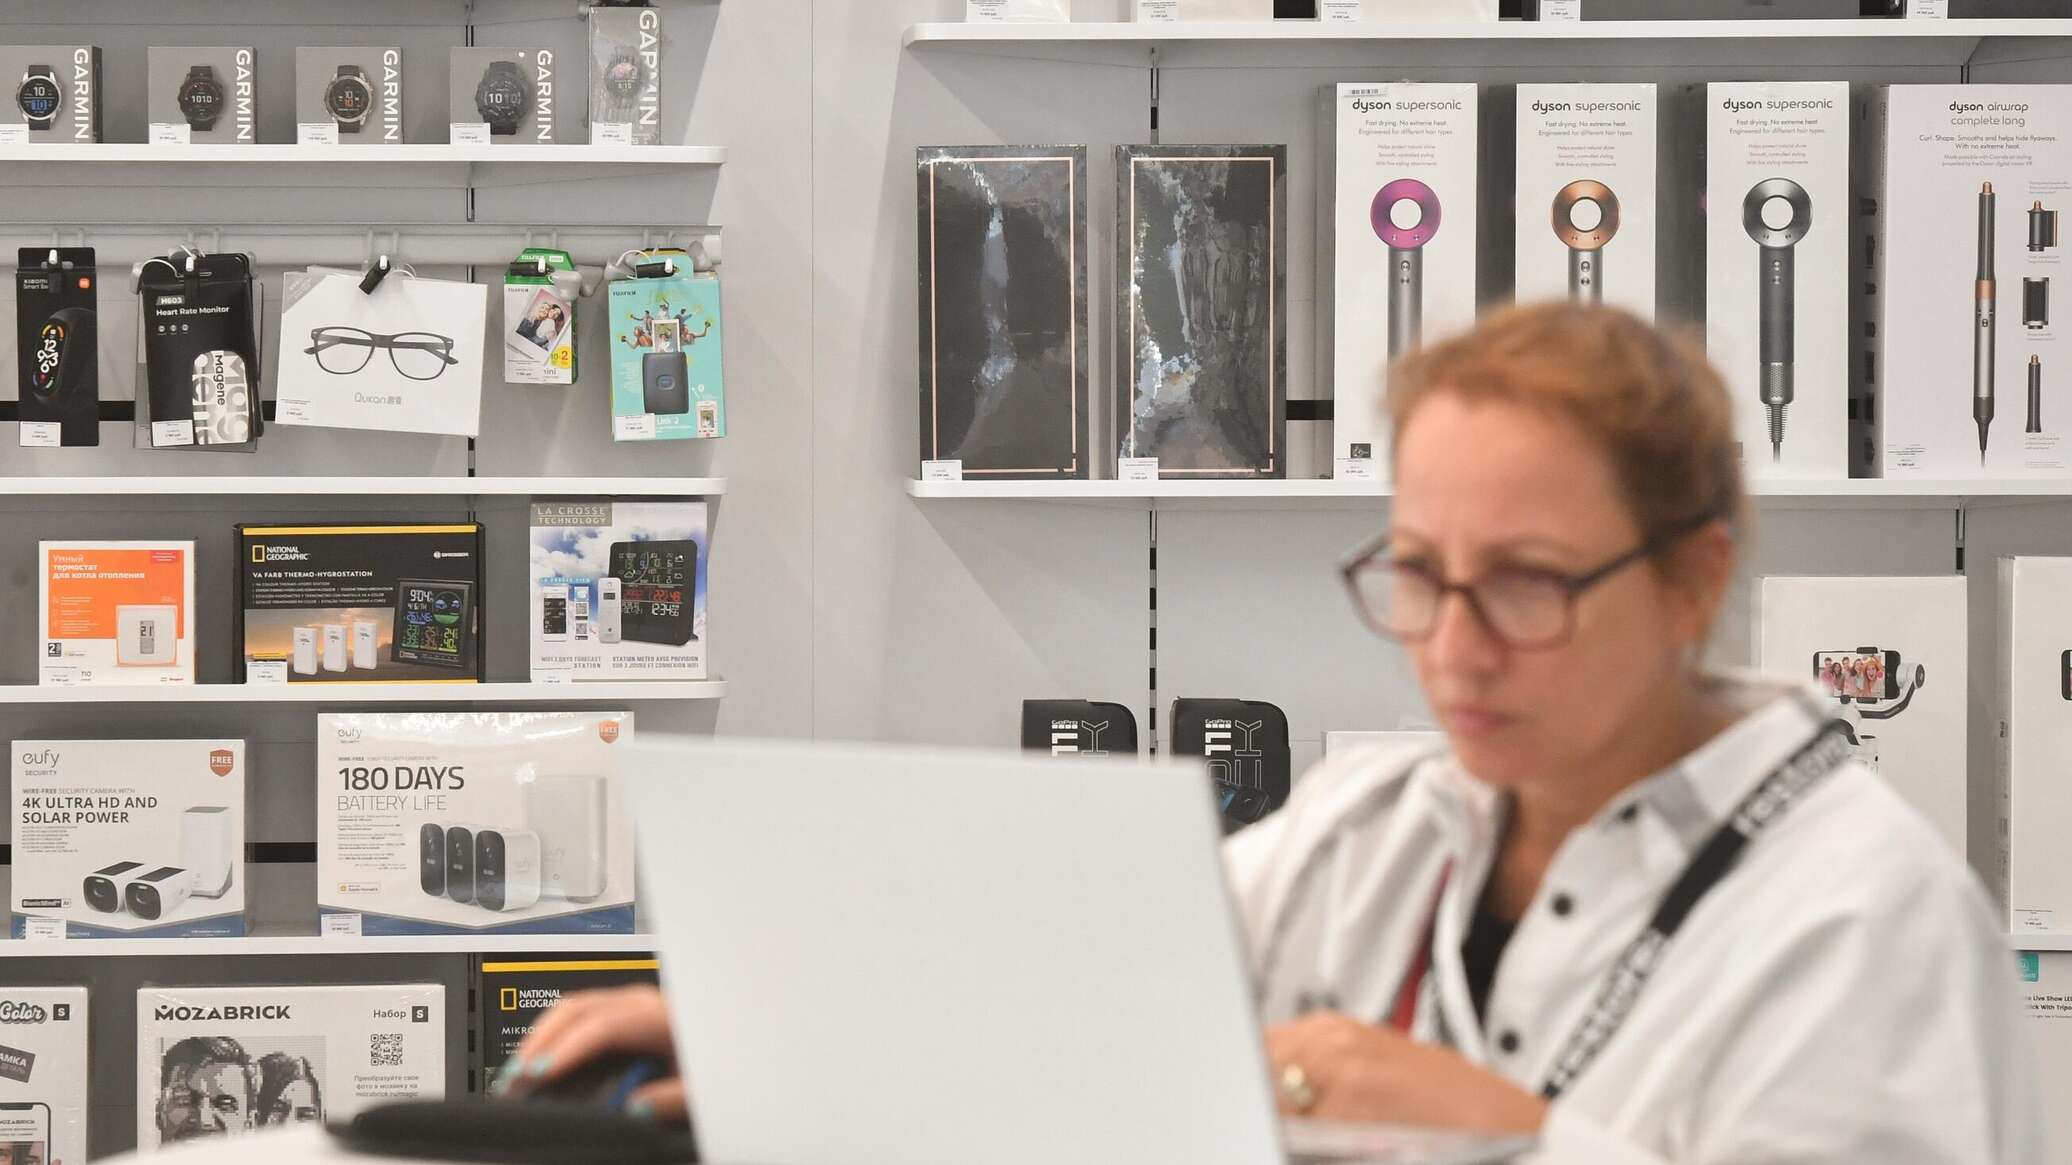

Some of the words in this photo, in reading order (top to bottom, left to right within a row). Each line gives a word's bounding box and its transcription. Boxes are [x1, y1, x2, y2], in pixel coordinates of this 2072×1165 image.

[639, 10, 657, 125] GARMIN
[33, 87, 45, 96] 10
[74, 48, 89, 139] GARMIN
[236, 49, 250, 140] GARMIN
[383, 50, 398, 140] GARMIN
[537, 50, 551, 140] GARMIN
[1352, 98, 1391, 113] dyson
[1395, 99, 1462, 112] supersonic
[1532, 100, 1571, 114] dyson
[1575, 100, 1641, 113] supersonic
[1723, 98, 1762, 113] dyson
[1766, 98, 1833, 111] supersonic
[1949, 101, 1983, 113] dyson
[1987, 101, 2029, 113] airwrap
[1950, 115, 2000, 127] complete
[2001, 115, 2025, 127] long
[1958, 134, 1984, 142] Smooths
[1985, 134, 1996, 142] and
[1998, 134, 2014, 142] helps
[2016, 134, 2028, 142] hide
[179, 307, 197, 315] Rate
[199, 305, 230, 314] Monitor
[213, 354, 226, 405] Magene
[537, 506, 552, 515] LA
[558, 506, 605, 515] CROSSE
[53, 554, 84, 563] Умный
[266, 553, 309, 561] GEOGRAPHIC
[284, 570, 373, 578] THERMO-HYGROSTATION
[49, 644, 56, 654] 2
[338, 727, 361, 740] eufy
[22, 749, 60, 767] eufy
[211, 756, 233, 764] FREE
[24, 769, 57, 777] SECURITY
[338, 766, 388, 790] 180
[395, 766, 465, 790] DAYS
[22, 797, 41, 809] 4K
[45, 797, 94, 809] ULTRA
[98, 797, 120, 809] HD
[124, 797, 158, 809] AND
[337, 795, 408, 811] BATTERY
[413, 795, 447, 811] LIFE
[22, 812, 71, 824] SOLAR
[75, 812, 129, 824] POWER
[519, 989, 561, 999] NATIONAL
[0, 1001, 46, 1023] Color
[154, 1004, 291, 1021] MOZABRICK
[373, 1009, 407, 1021] Набор
[356, 1082, 373, 1090] фото
